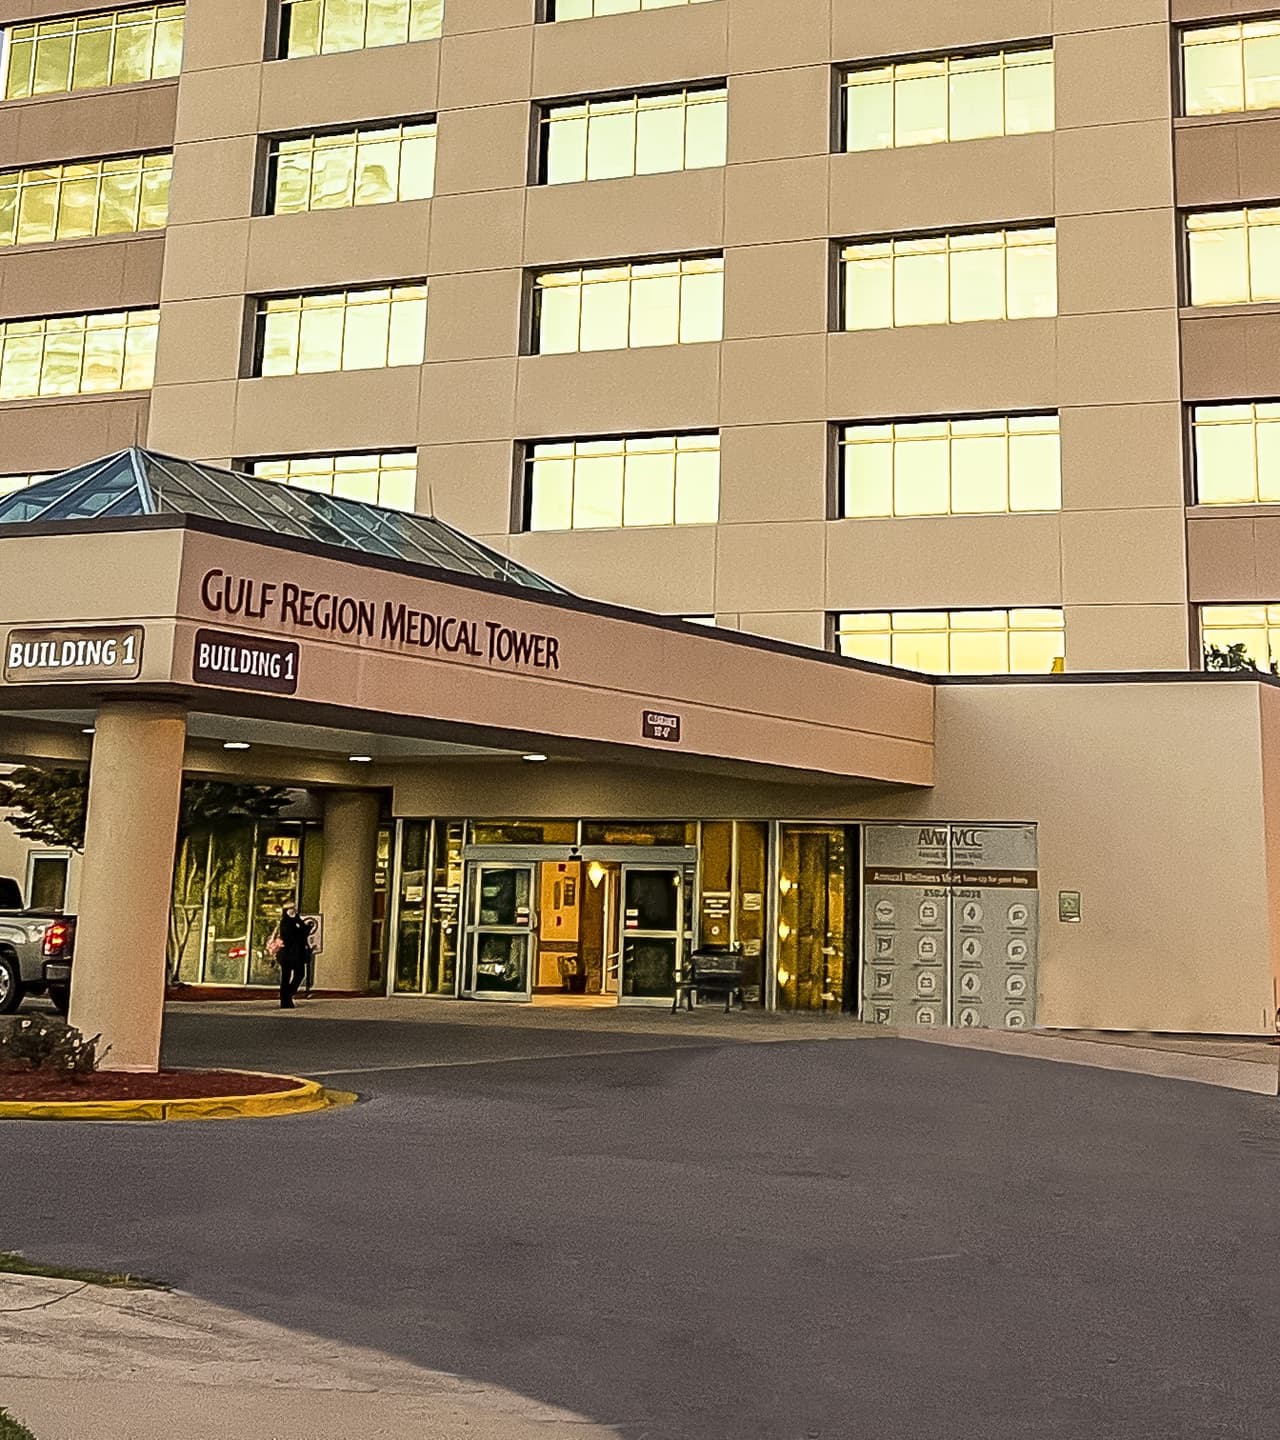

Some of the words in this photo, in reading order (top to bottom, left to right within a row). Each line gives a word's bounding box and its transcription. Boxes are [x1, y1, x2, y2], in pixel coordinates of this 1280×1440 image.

[201, 568, 277, 619] GULF
[280, 582, 375, 637] REGION
[381, 601, 483, 657] MEDICAL
[485, 621, 559, 670] TOWER
[8, 639, 117, 668] BUILDING
[122, 635, 136, 665] 1
[199, 643, 281, 678] BUILDING
[284, 652, 295, 680] 1
